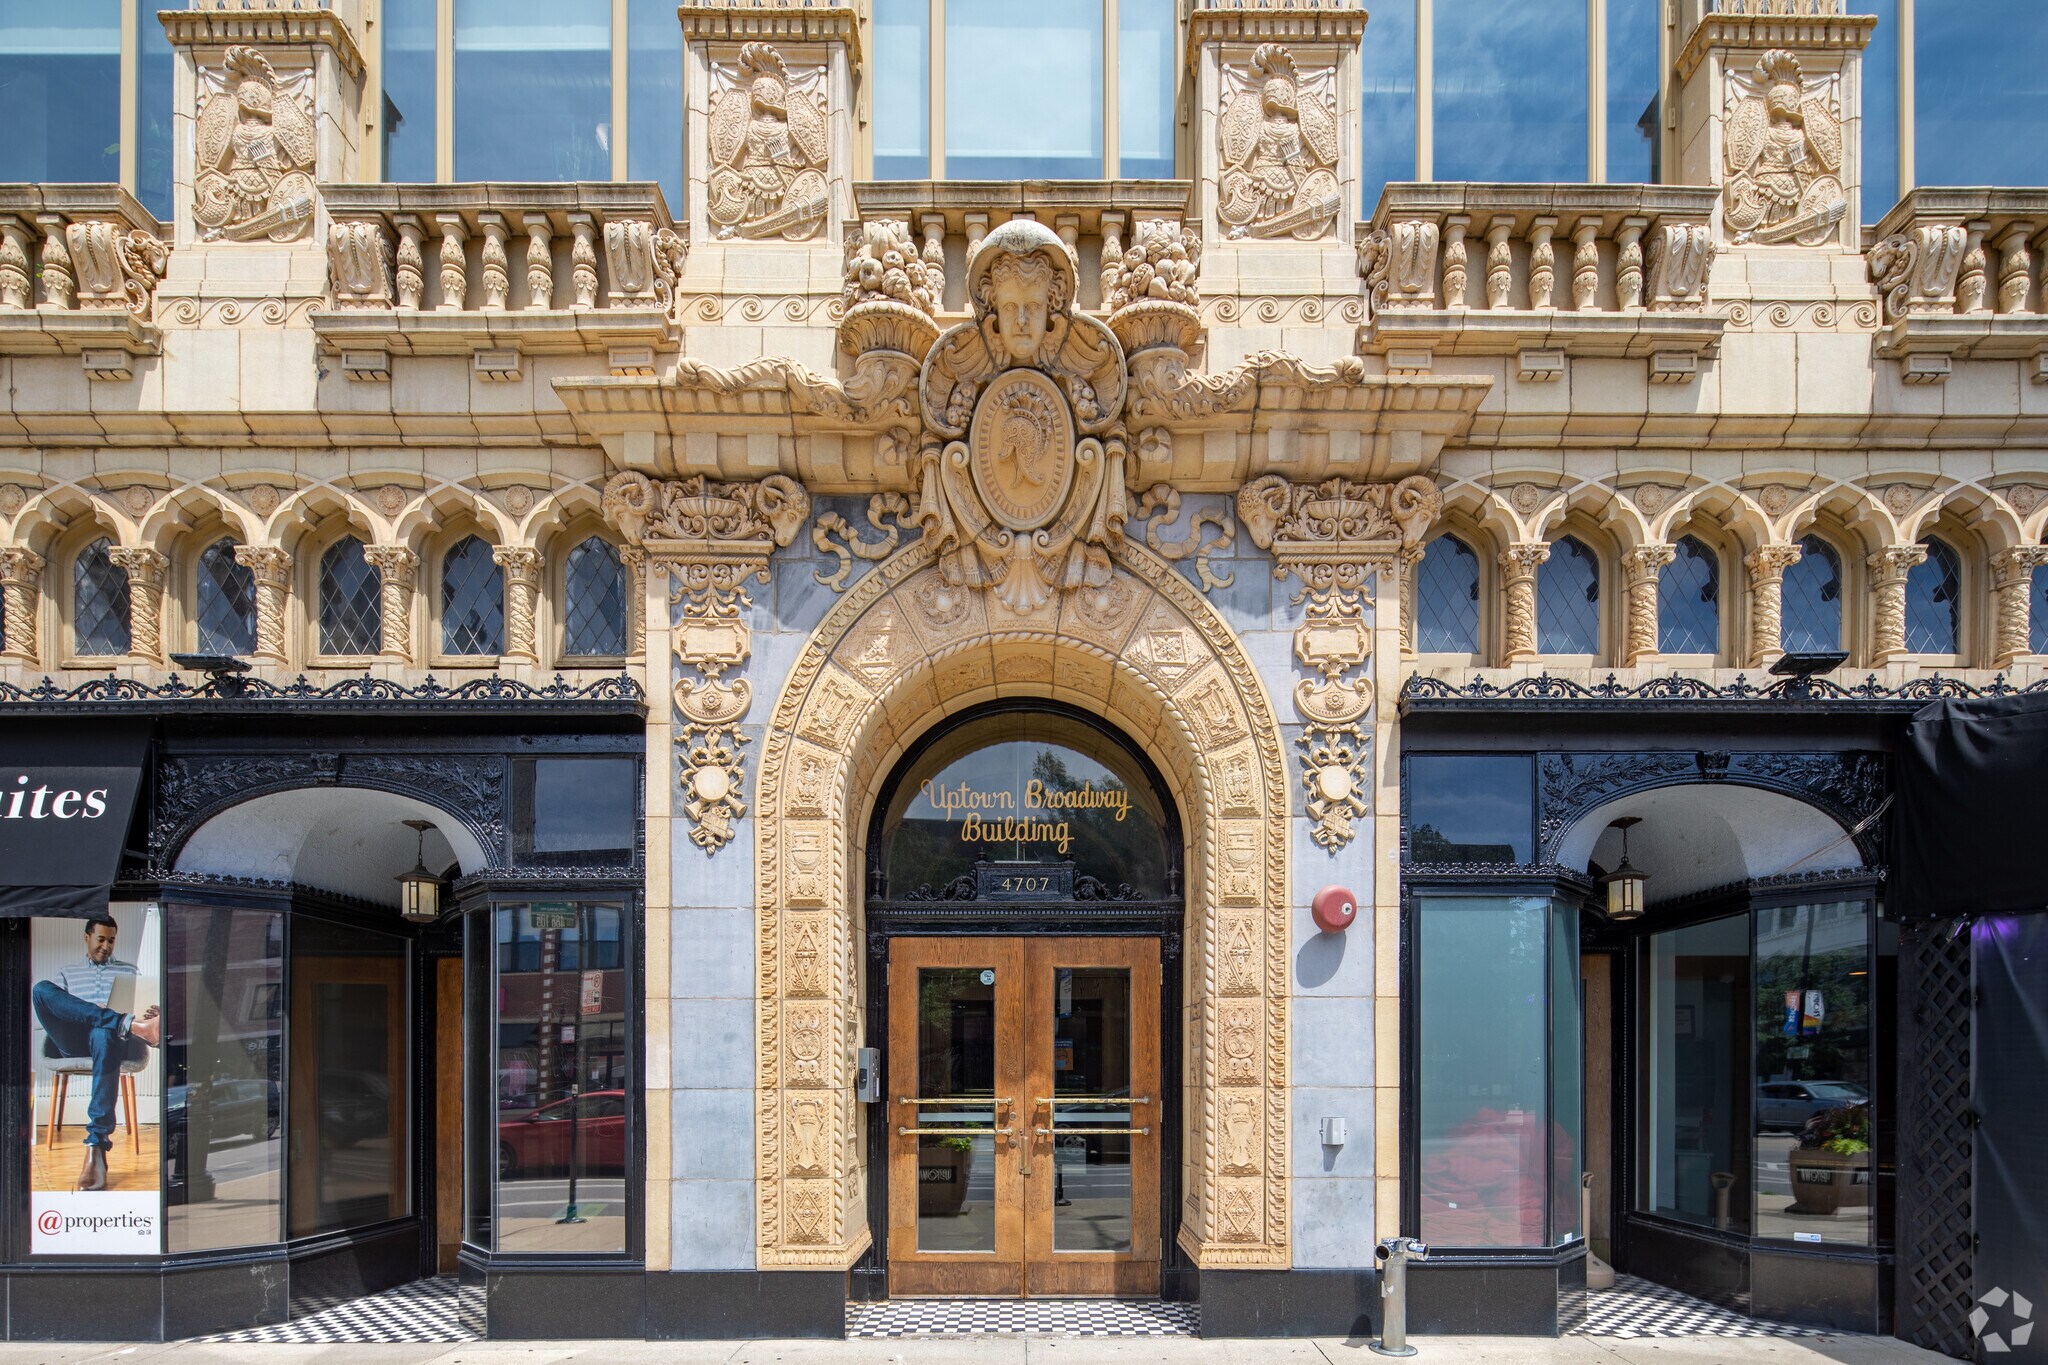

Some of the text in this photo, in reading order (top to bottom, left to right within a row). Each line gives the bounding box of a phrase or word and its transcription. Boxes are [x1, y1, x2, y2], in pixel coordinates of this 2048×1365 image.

[0, 775, 108, 819] ites
[920, 778, 1133, 822] Uptown Broadway
[961, 812, 1075, 854] Building
[1002, 877, 1049, 892] 4707
[38, 1210, 154, 1236] @properties
